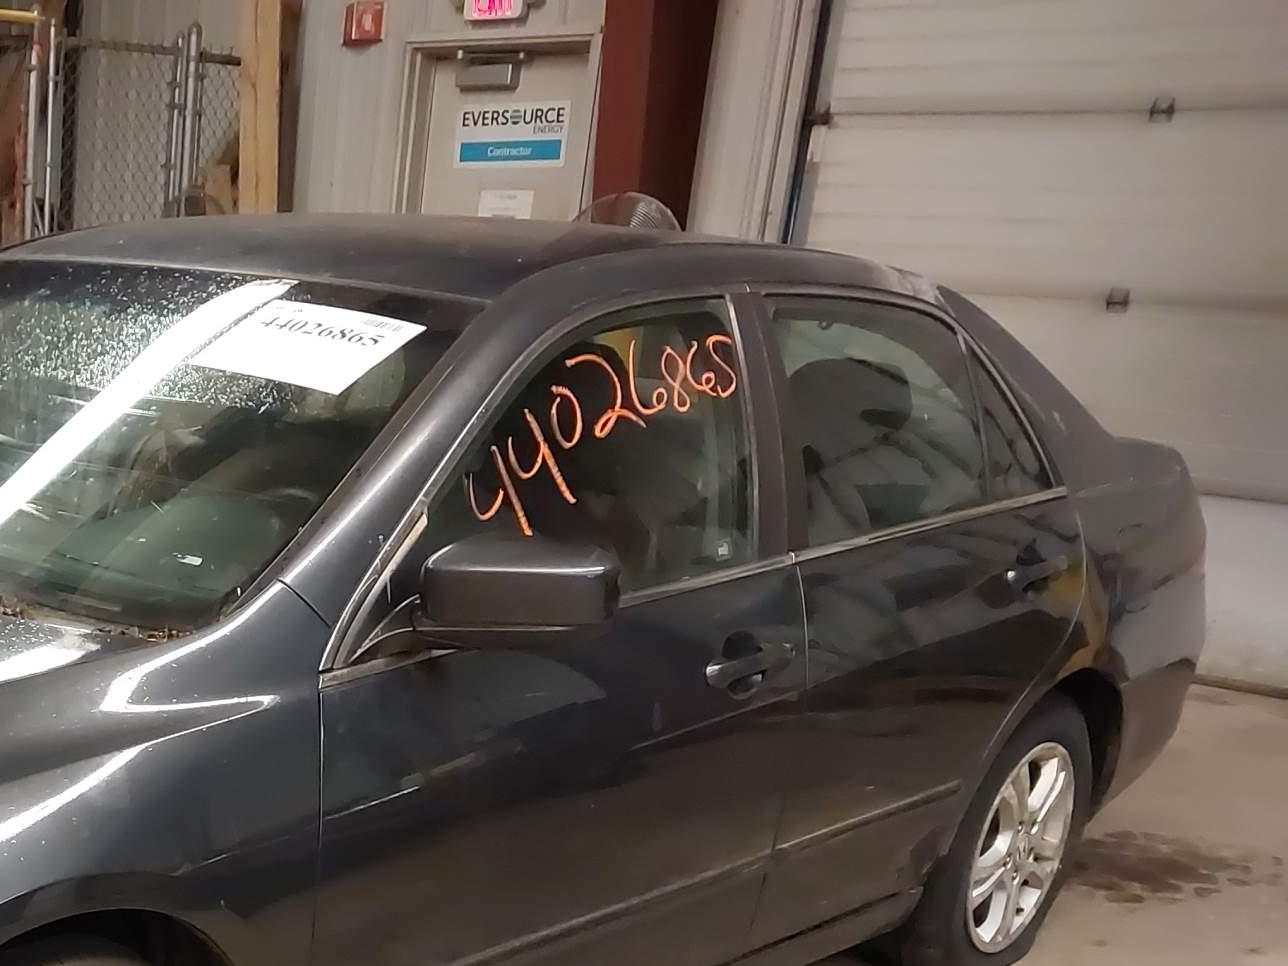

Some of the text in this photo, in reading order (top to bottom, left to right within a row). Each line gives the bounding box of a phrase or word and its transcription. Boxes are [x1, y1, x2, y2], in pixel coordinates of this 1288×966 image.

[462, 107, 566, 127] EVERSOURCE
[533, 126, 564, 135] ENERGY
[487, 146, 532, 157] Contractor
[261, 315, 385, 347] 44026865
[464, 334, 737, 537] 44026865
